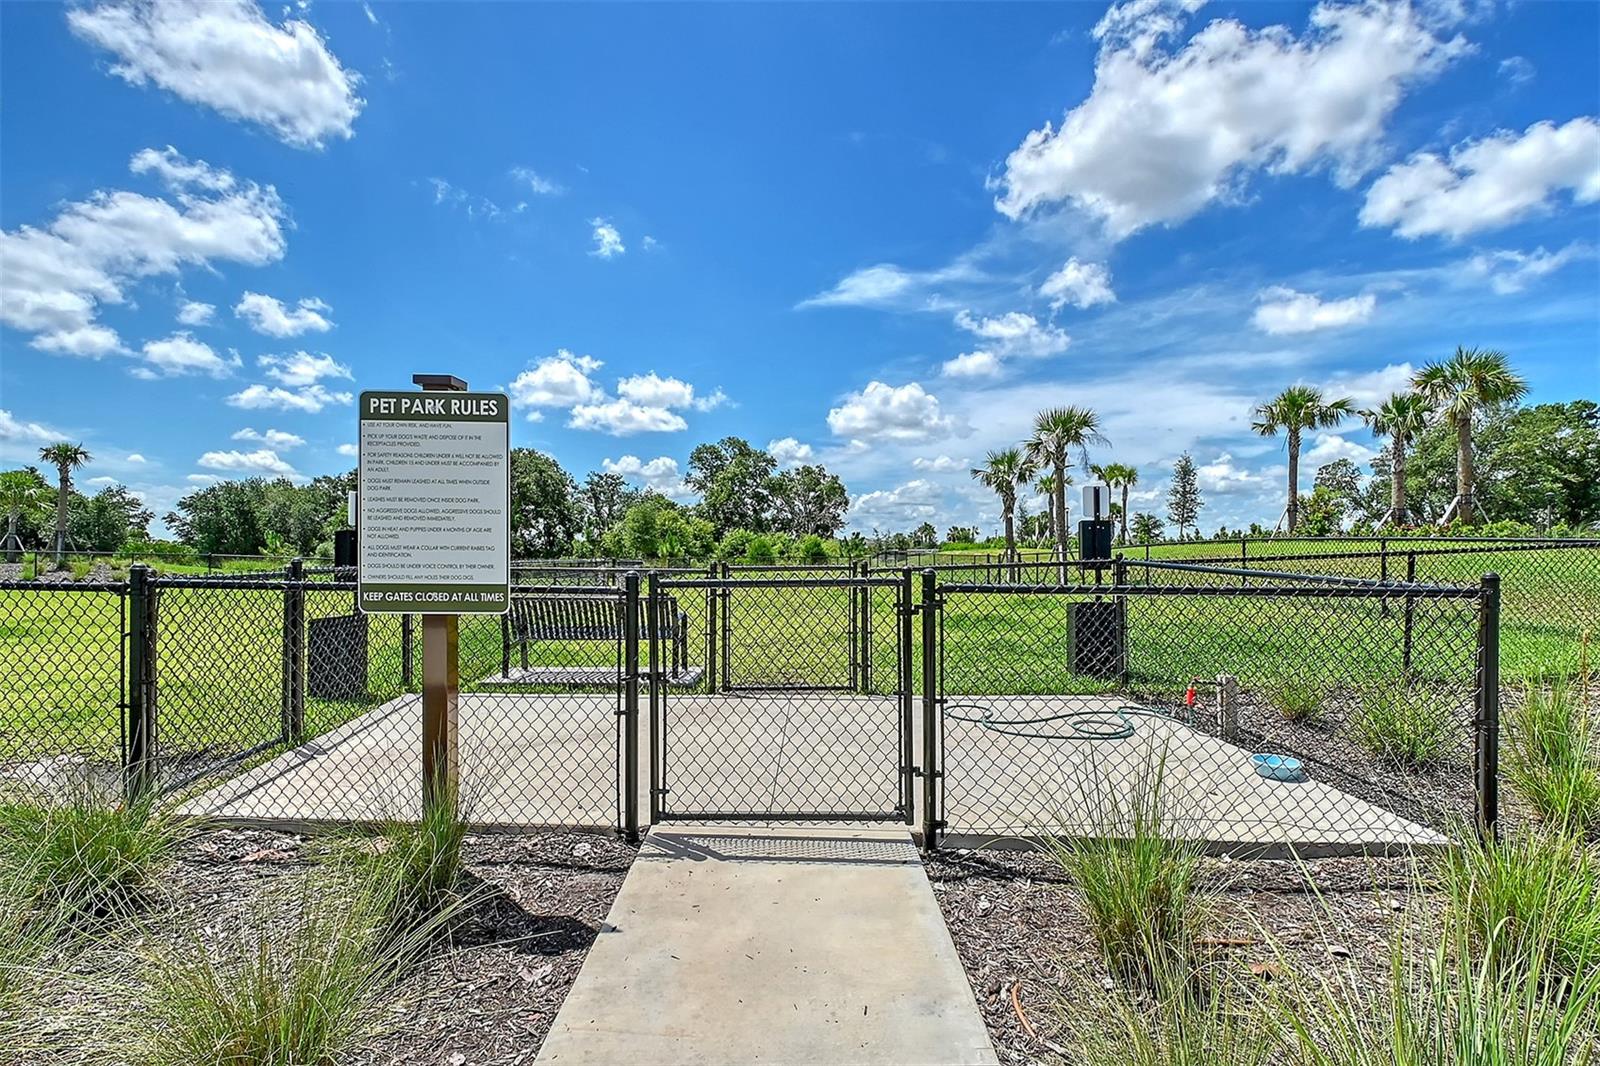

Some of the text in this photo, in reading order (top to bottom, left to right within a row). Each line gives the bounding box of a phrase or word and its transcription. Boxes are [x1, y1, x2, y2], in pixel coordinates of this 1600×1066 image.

[370, 398, 498, 415] PET PARK RULES
[363, 592, 504, 602] KEEP GATES CLOSED AT ALL TIMES
